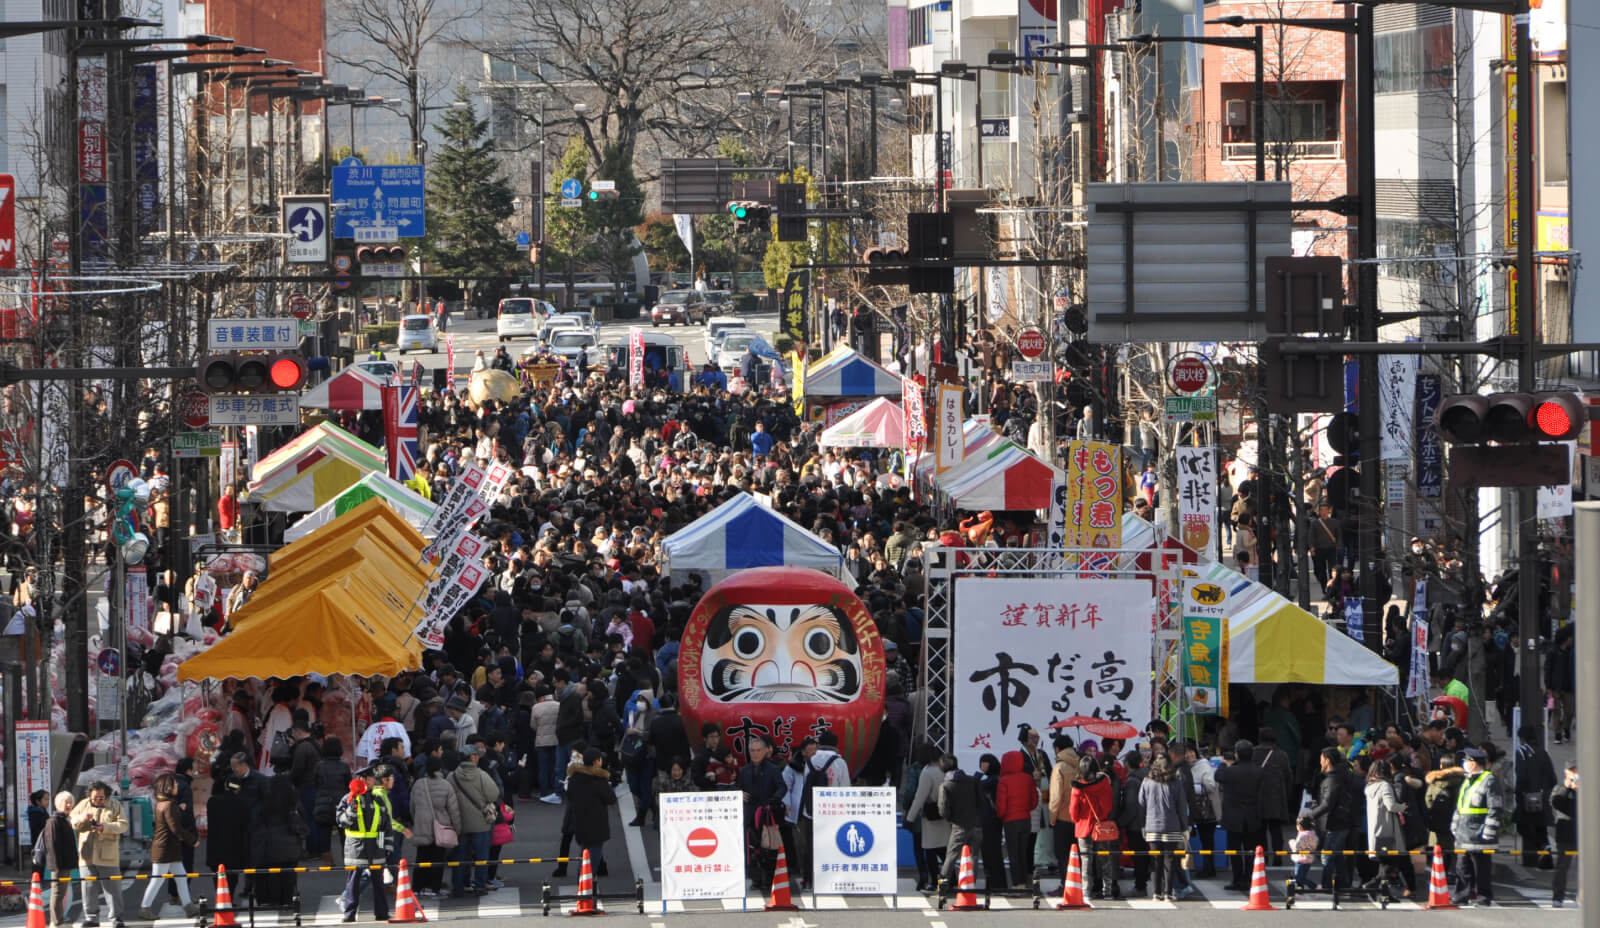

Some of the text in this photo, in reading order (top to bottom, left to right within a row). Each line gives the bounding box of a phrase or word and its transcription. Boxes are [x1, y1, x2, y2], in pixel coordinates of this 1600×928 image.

[216, 327, 291, 343] 音響装置付
[1176, 368, 1205, 382] 消火栓
[216, 399, 293, 413] 歩車分離式
[1420, 377, 1438, 484] セントラルホテル
[1090, 449, 1117, 528] もつ煮
[999, 602, 1103, 629] 謹賀新年
[969, 652, 1039, 735] 市
